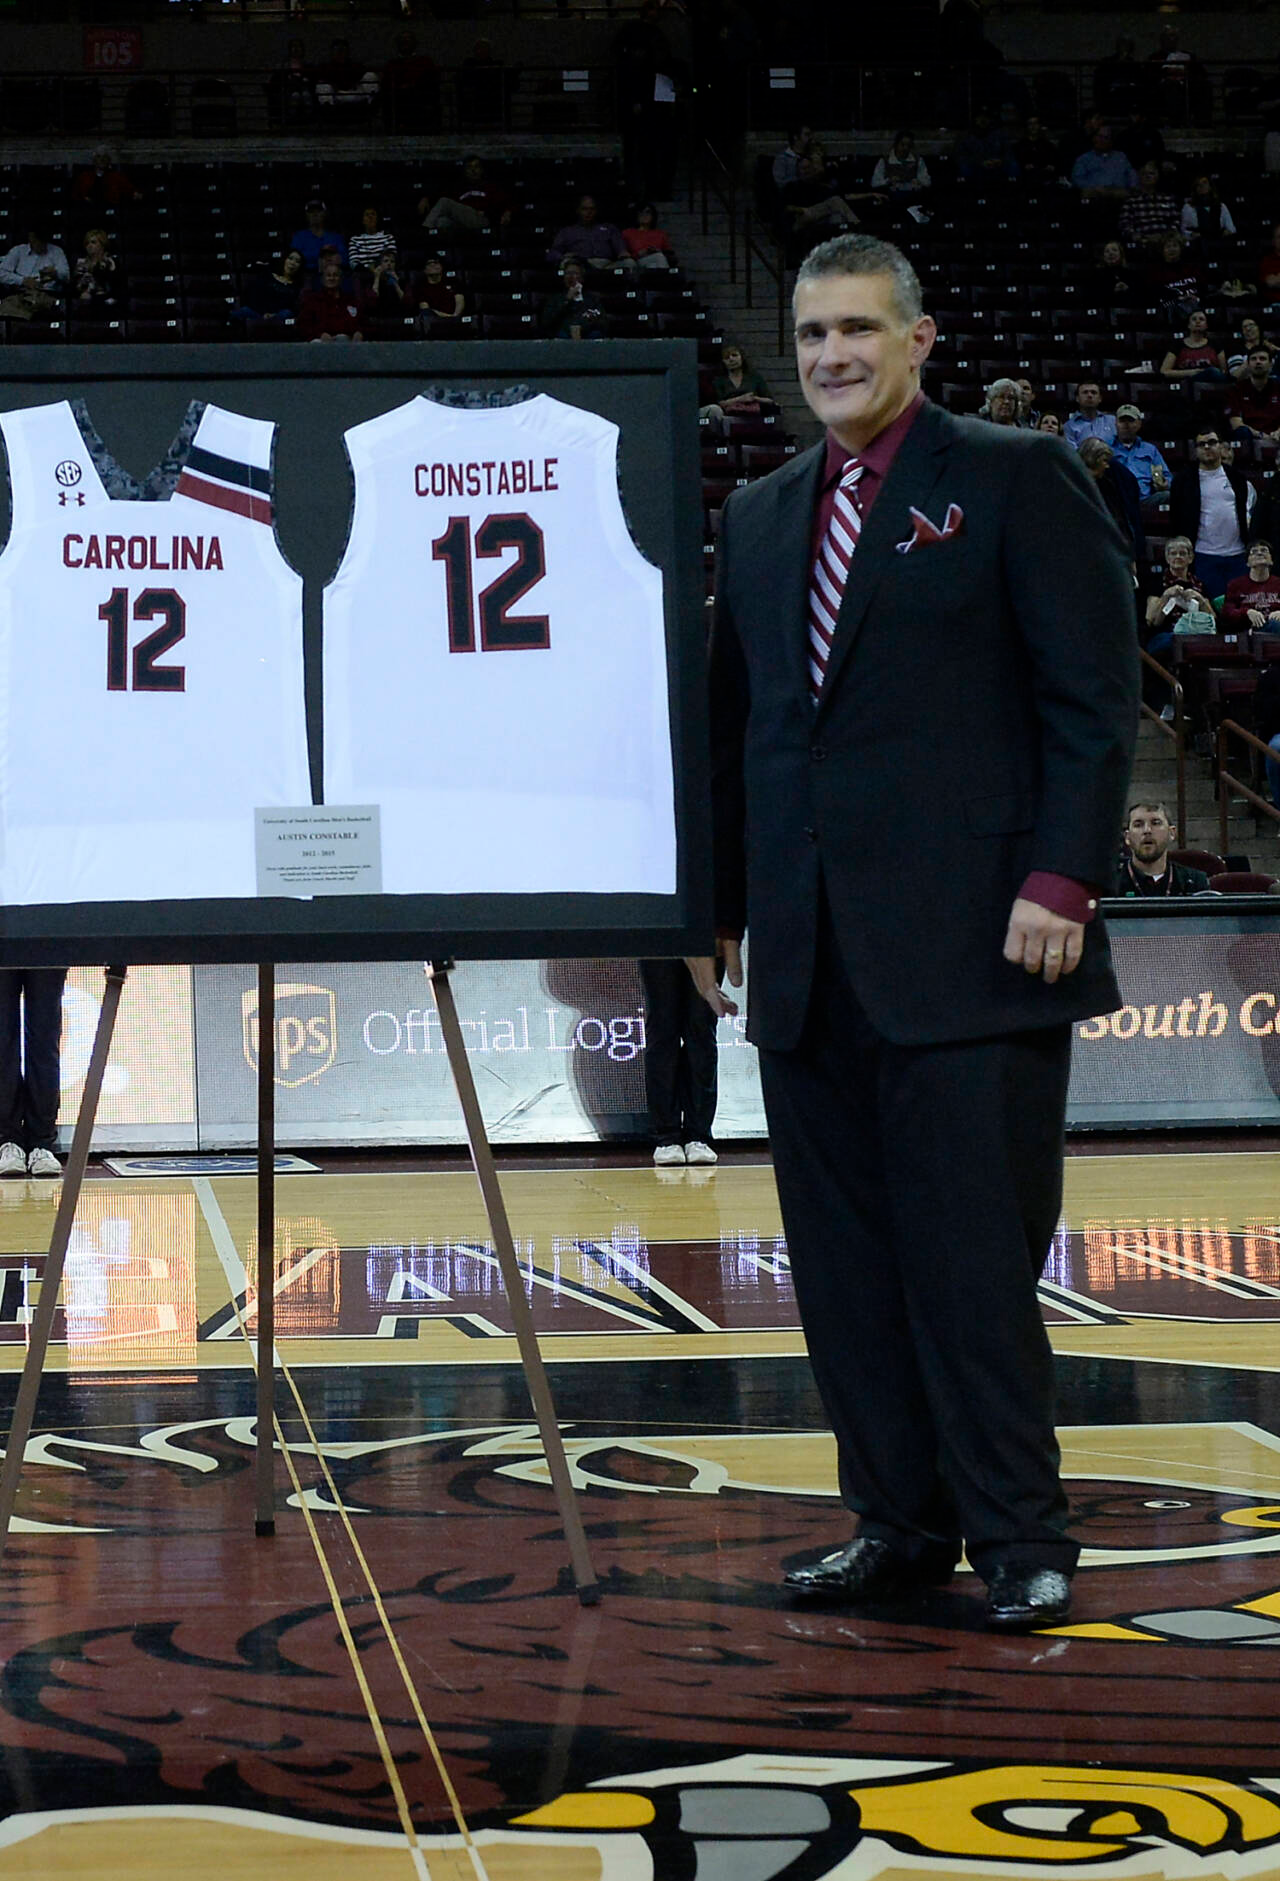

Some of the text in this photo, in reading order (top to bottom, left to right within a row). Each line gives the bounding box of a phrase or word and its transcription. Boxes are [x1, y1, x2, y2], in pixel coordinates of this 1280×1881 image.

[95, 42, 133, 65] 105
[56, 461, 81, 486] SEC
[414, 458, 559, 497] CONSTABLE
[63, 534, 224, 571] CAROLINA
[432, 512, 551, 654] 12
[98, 586, 186, 692] 12
[277, 832, 359, 841] AUSTIN CONSTABLE
[363, 1006, 533, 1055] Offial
[1239, 991, 1280, 1037] C
